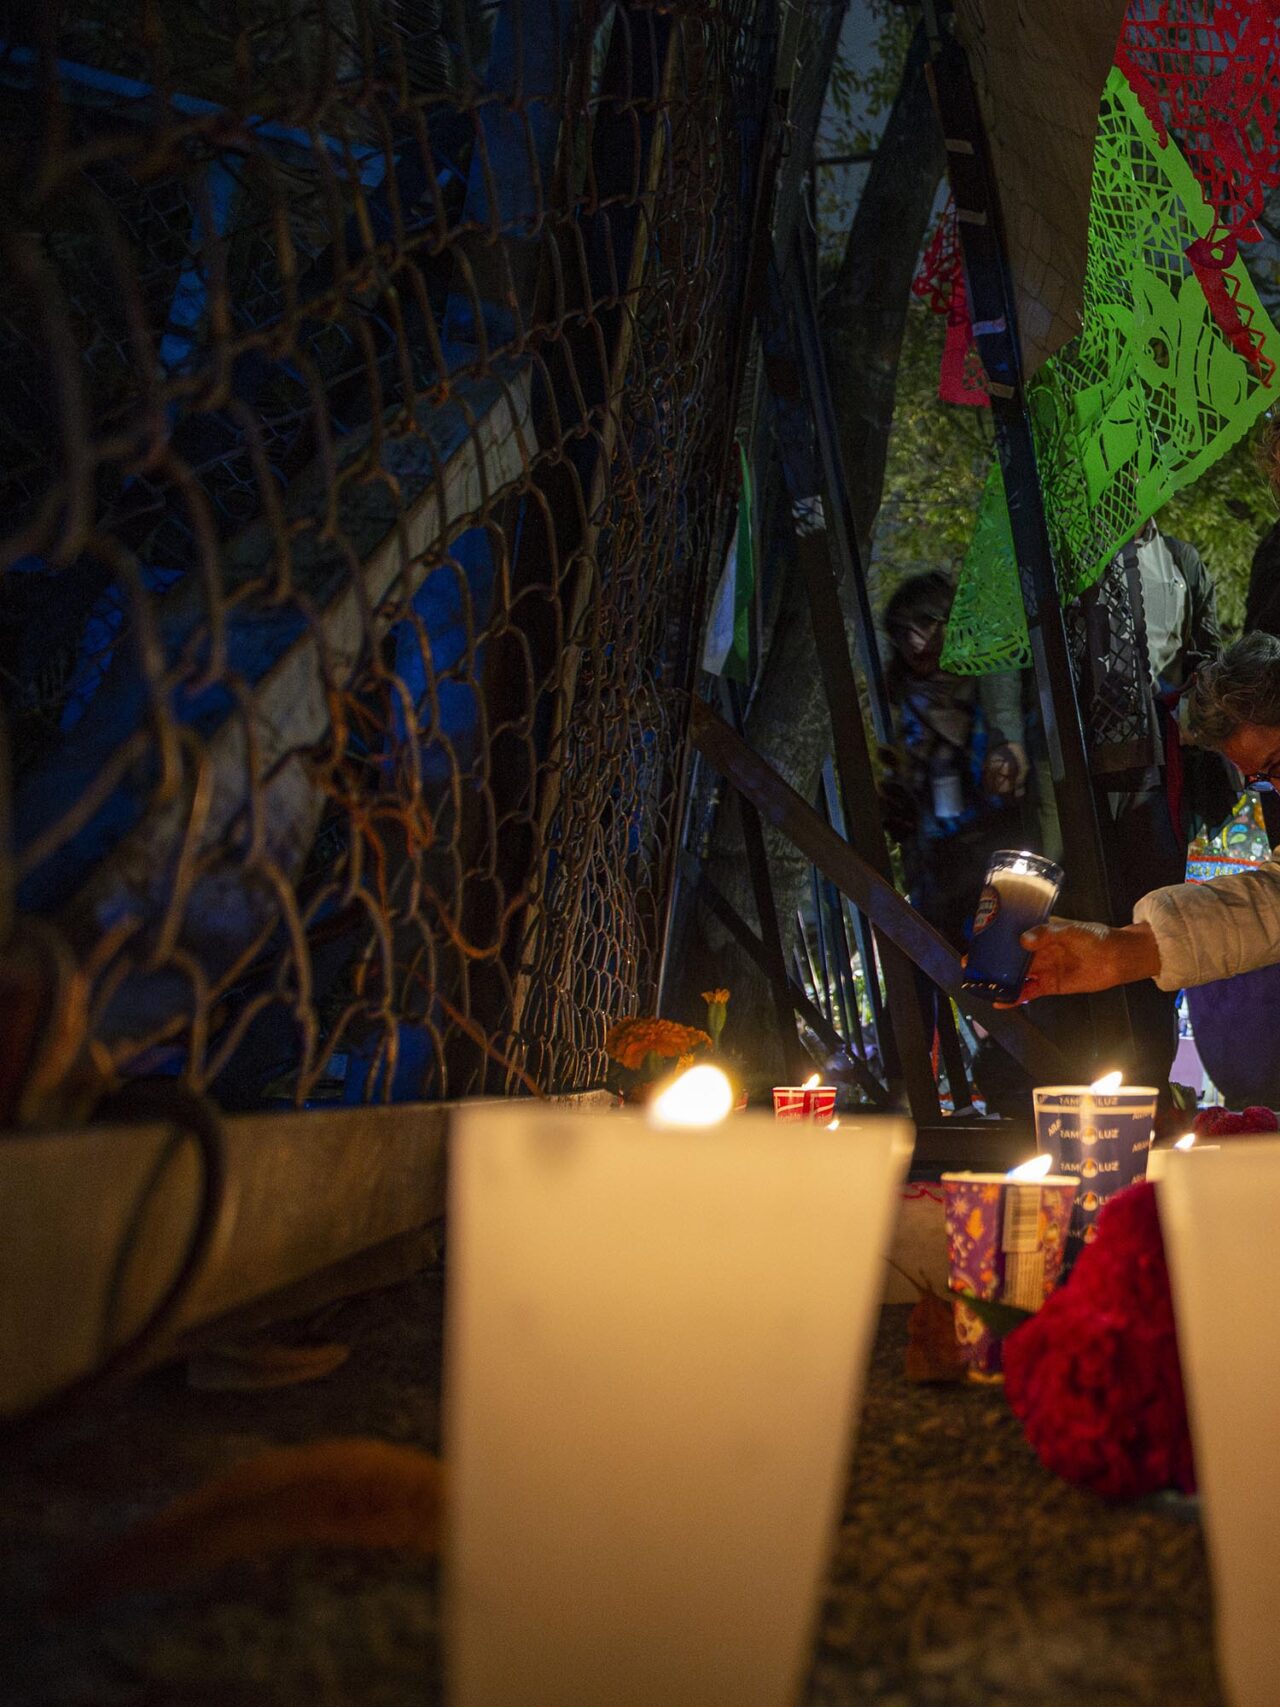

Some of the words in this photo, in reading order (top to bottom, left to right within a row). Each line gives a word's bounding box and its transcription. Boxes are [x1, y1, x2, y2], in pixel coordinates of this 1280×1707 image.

[1098, 1097, 1119, 1106] LUZ
[1098, 1129, 1119, 1139] LUZ
[1098, 1161, 1119, 1171] LUZ
